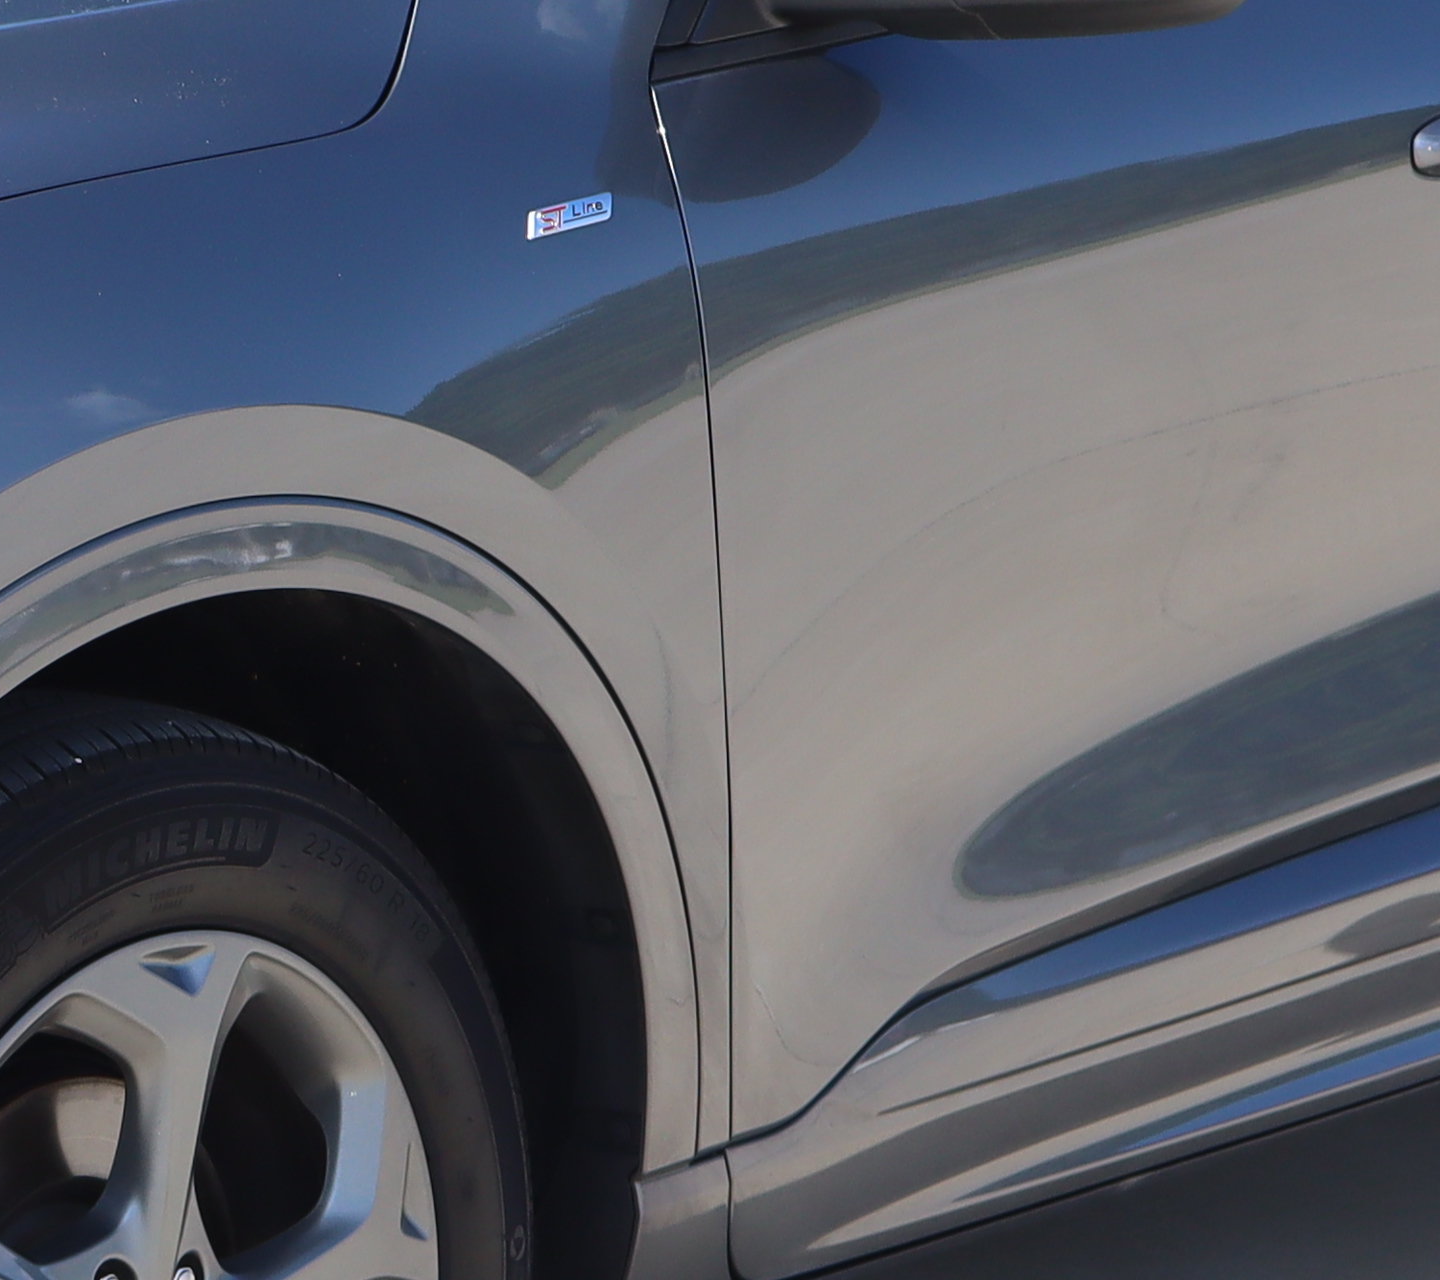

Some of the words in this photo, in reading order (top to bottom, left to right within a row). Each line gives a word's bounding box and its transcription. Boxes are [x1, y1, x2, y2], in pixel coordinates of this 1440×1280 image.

[539, 205, 568, 233] ST
[572, 201, 604, 218] Line
[41, 816, 269, 916] MICHELIN
[302, 831, 385, 895] 225/60
[386, 890, 406, 914] R
[409, 912, 430, 943] 18
